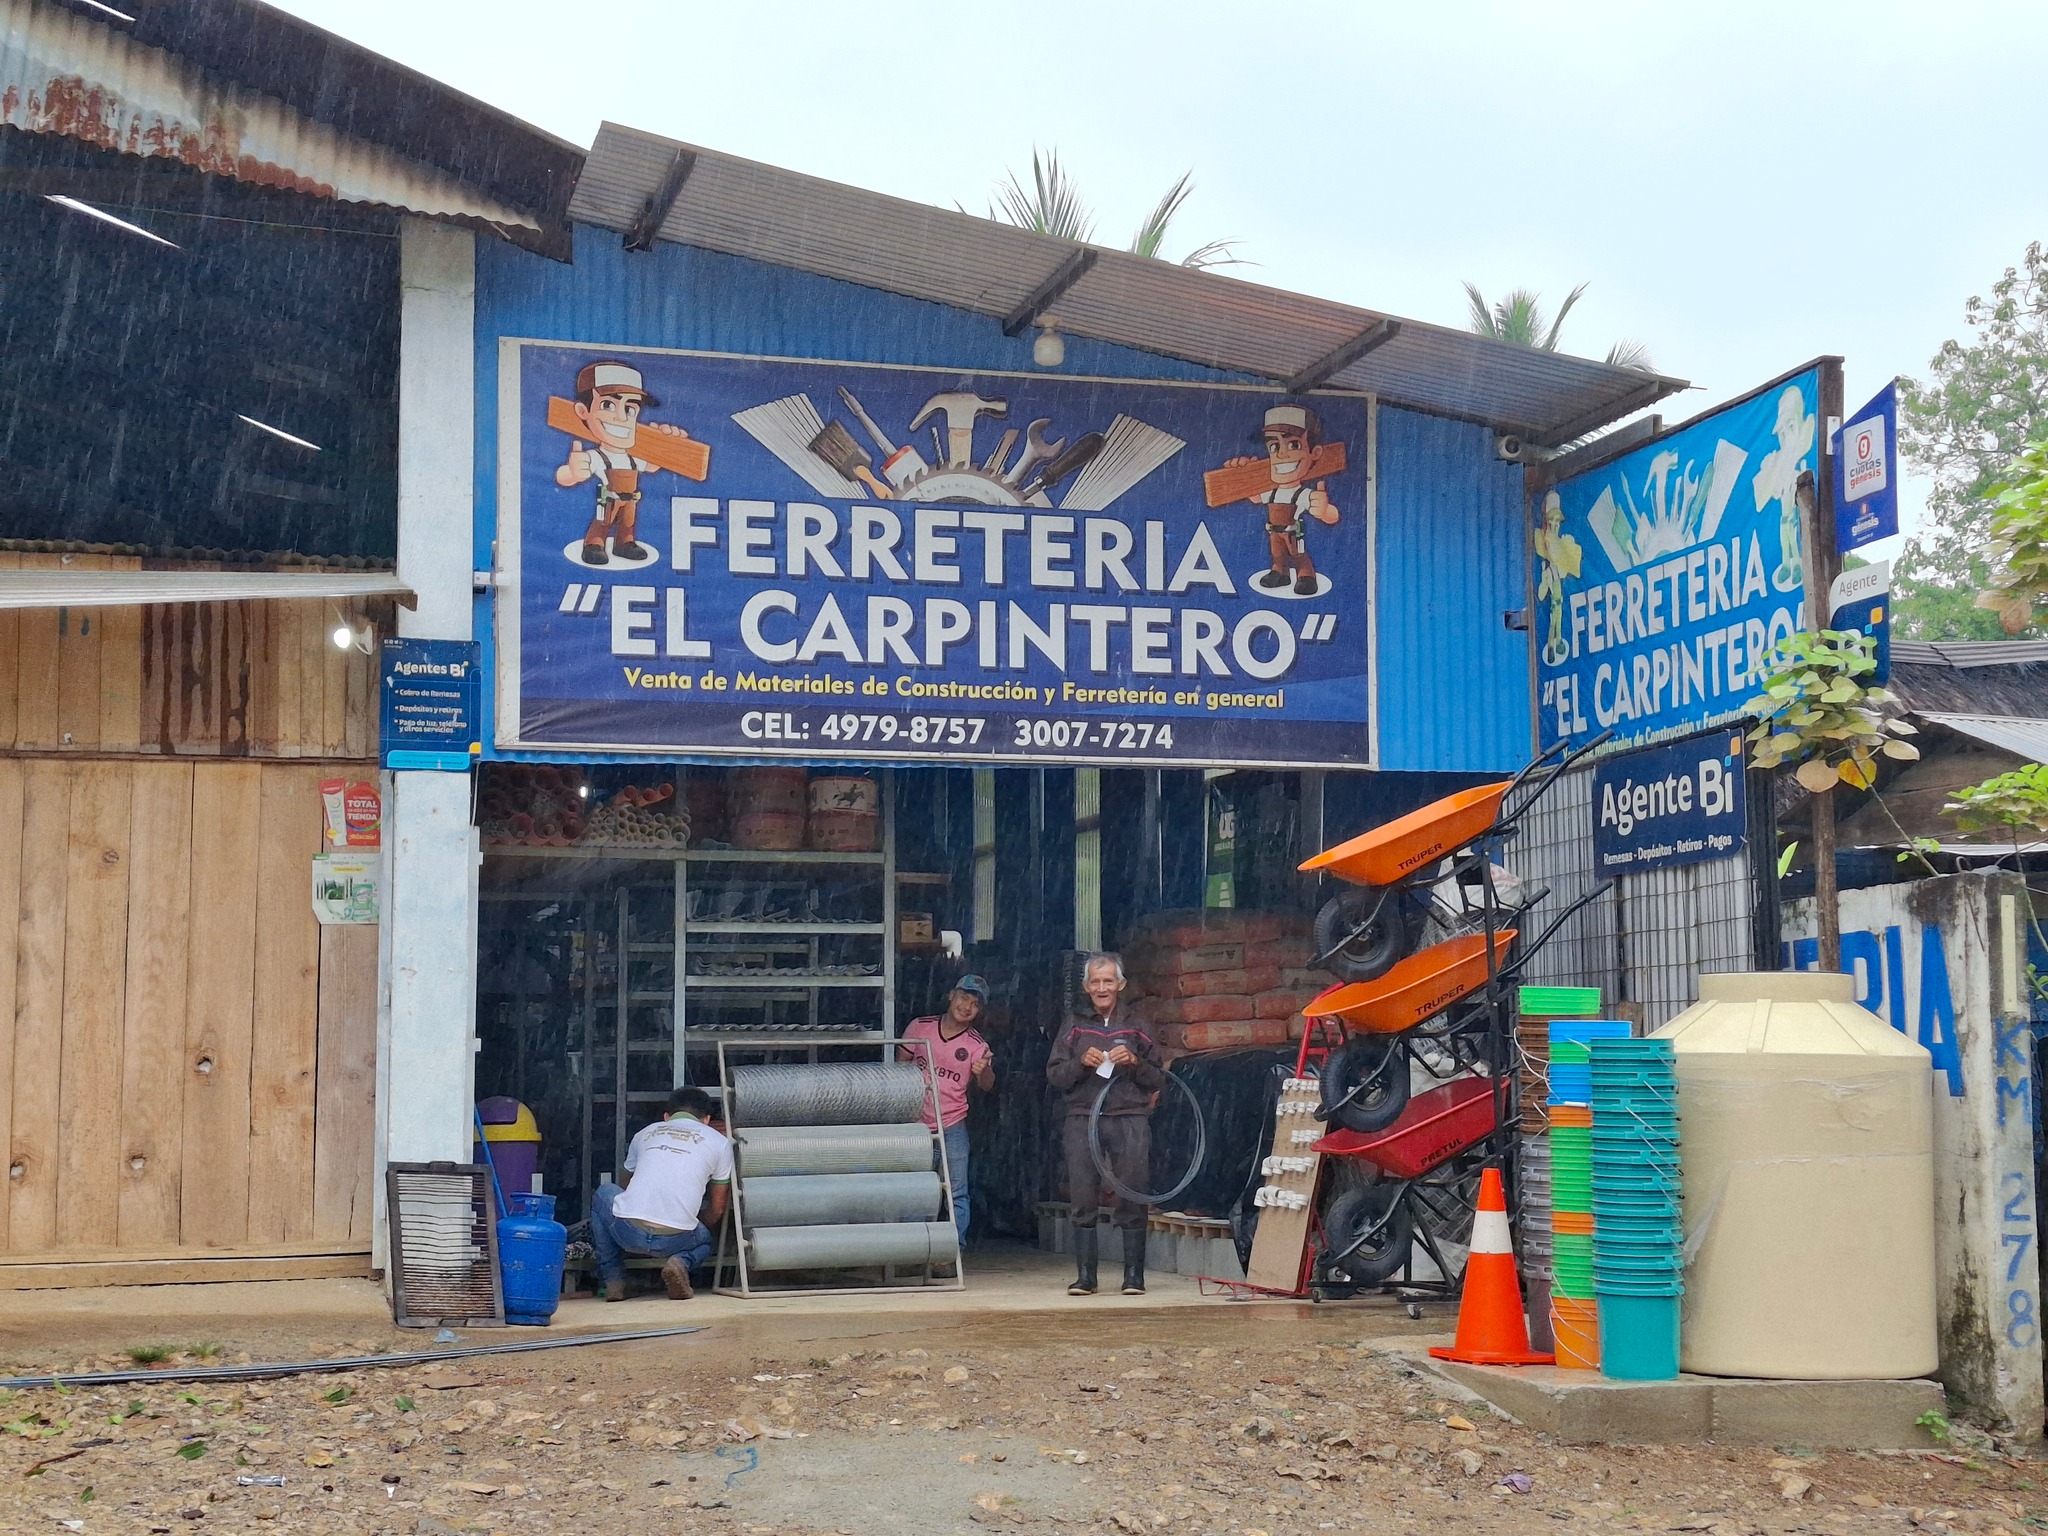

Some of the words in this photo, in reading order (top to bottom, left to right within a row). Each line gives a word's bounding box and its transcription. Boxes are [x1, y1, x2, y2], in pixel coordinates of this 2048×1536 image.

[1849, 458, 1882, 479] cuotas
[670, 496, 1237, 594] FERRETERIA
[1570, 528, 1768, 659] FERRETERIA
[1839, 573, 1878, 597] Agente
[394, 660, 447, 676] Agentes
[449, 661, 469, 678] Bi
[623, 667, 692, 690] Venta
[700, 669, 727, 691] de
[735, 670, 854, 695] Materiales
[862, 675, 888, 696] de
[895, 675, 1037, 701] Construcción
[1043, 685, 1056, 706] y
[1062, 681, 1167, 705] Ferretería
[1173, 688, 1199, 706] en
[1205, 688, 1284, 711] general
[740, 711, 809, 740] CEL:
[820, 713, 986, 745] 4979-8757
[1013, 719, 1173, 750] 3007-7274
[1633, 727, 1645, 747] de
[347, 800, 378, 808] TOTAL
[1600, 771, 1693, 836] Agente
[1698, 755, 1734, 817] Bi
[347, 813, 378, 821] TIENDA
[1397, 842, 1443, 870] TRUPER
[1603, 852, 1633, 866] Remesas
[1677, 837, 1703, 853] Retiros
[1708, 834, 1733, 850] Pagos
[1414, 984, 1465, 1015] TRUPER
[1996, 1019, 2032, 1128] KM
[1420, 1137, 1463, 1167] PRETUL
[2002, 1172, 2037, 1348] 278
